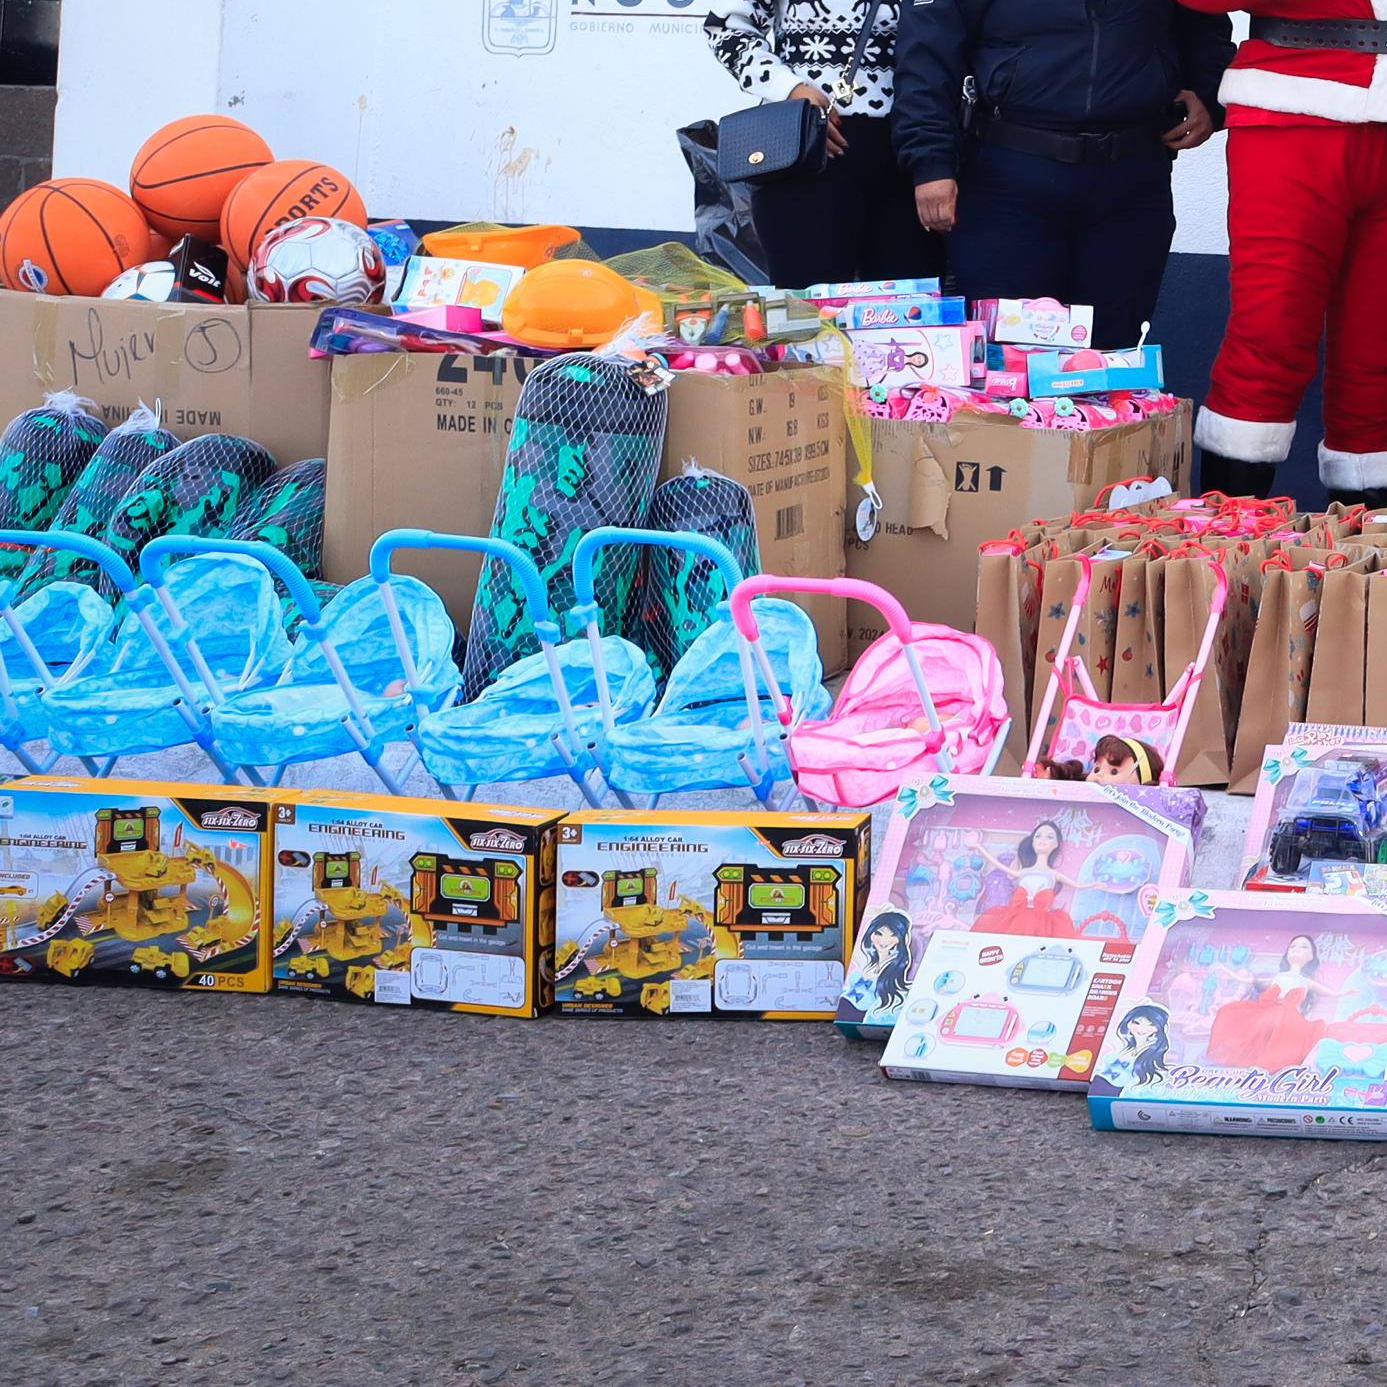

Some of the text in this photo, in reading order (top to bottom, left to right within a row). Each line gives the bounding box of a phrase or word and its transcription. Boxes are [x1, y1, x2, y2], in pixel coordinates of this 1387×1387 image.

[570, 22, 705, 35] GOBIERNO MUNICI
[264, 176, 339, 234] PORTS
[862, 308, 898, 325] Barbie
[68, 307, 155, 386] Mujer
[467, 400, 476, 409] 12
[437, 414, 476, 432] MADE
[483, 417, 497, 433] IN
[886, 522, 913, 535] HEAD
[308, 824, 405, 841] ENGINEERING
[562, 827, 577, 839] 3+
[597, 842, 708, 853] ENGINEERING
[198, 974, 245, 988] 40 PCS
[1169, 1065, 1341, 1102] Beauty Girl
